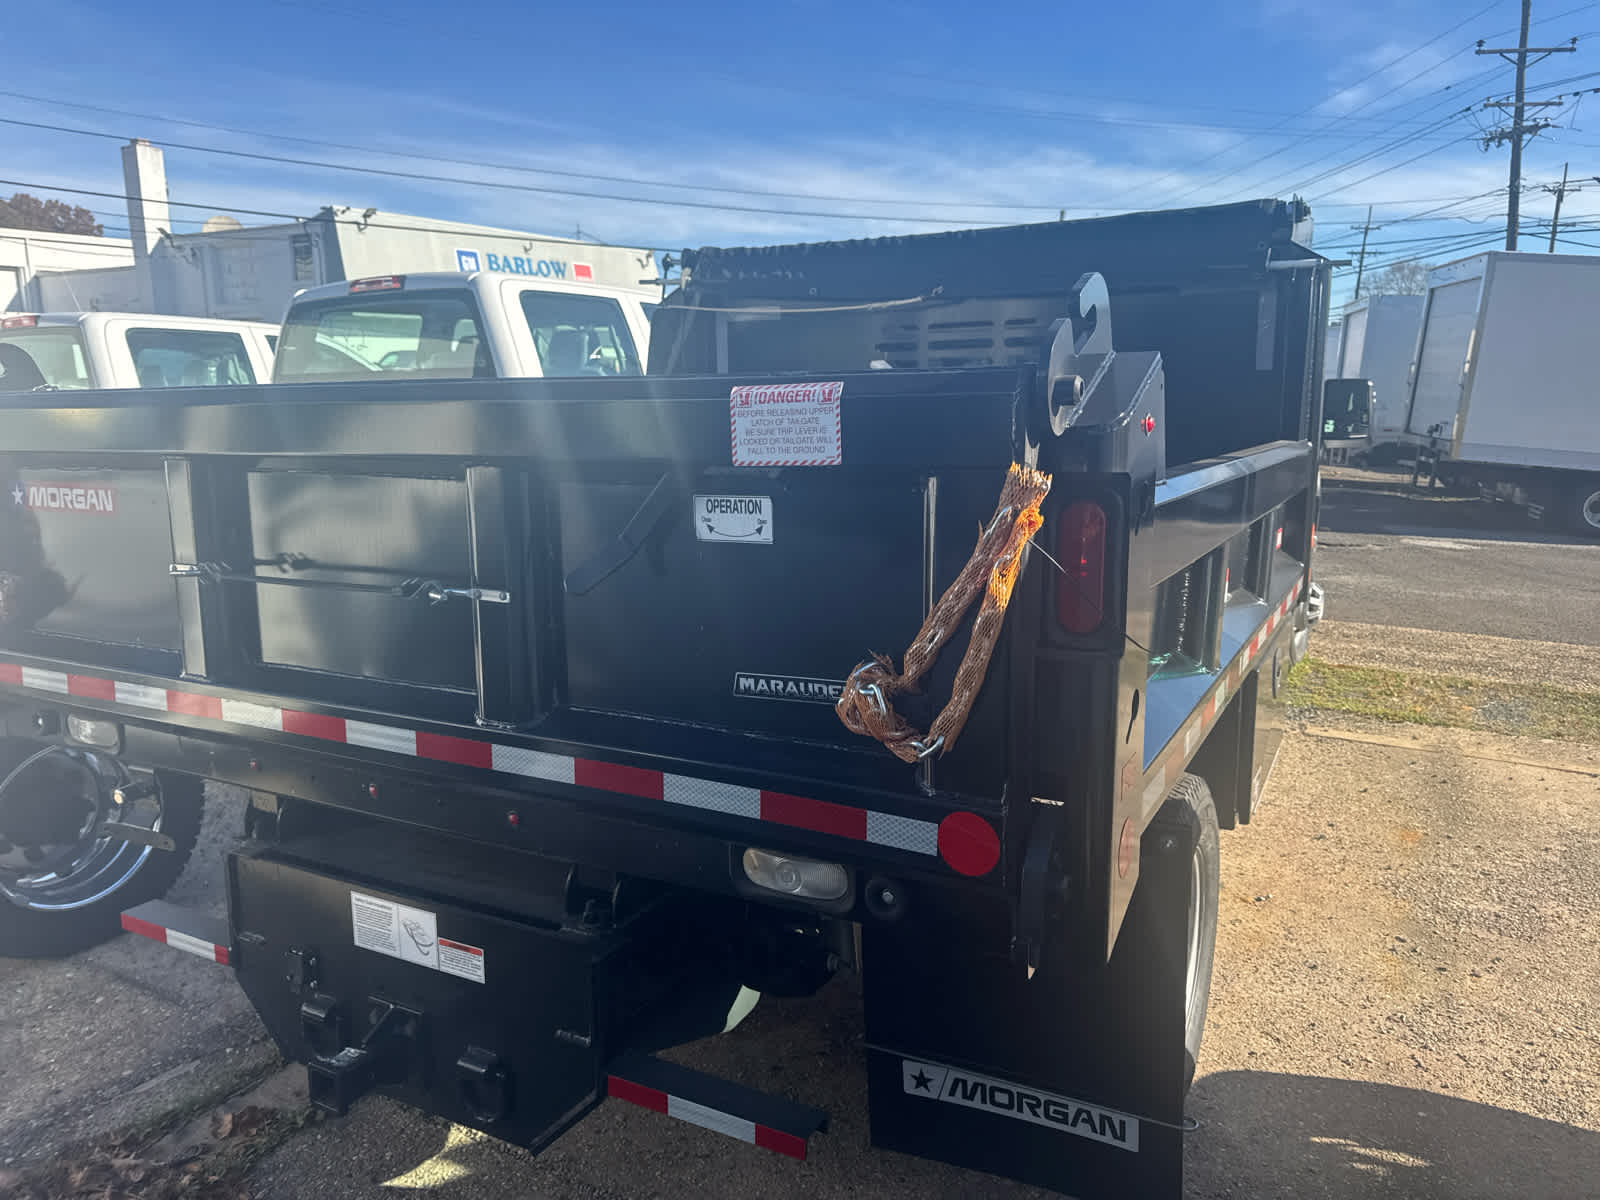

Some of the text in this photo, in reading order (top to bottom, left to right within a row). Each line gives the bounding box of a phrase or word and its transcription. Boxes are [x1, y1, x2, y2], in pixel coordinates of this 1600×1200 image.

[486, 253, 567, 280] BARLOW
[737, 406, 834, 418] BEFORE RELEASING UPPER
[751, 416, 820, 427] LATCH OF TAILGATE
[777, 427, 793, 437] TRIP
[794, 426, 817, 436] LEVER
[740, 435, 833, 448] LOCKED OR TAILGATE WILL
[747, 445, 826, 456] FALL TO THE GROUND
[29, 486, 113, 512] MORGAN
[705, 498, 762, 514] OPERATION
[739, 677, 847, 699] MARAUDE
[948, 1076, 1127, 1143] MORGAN
